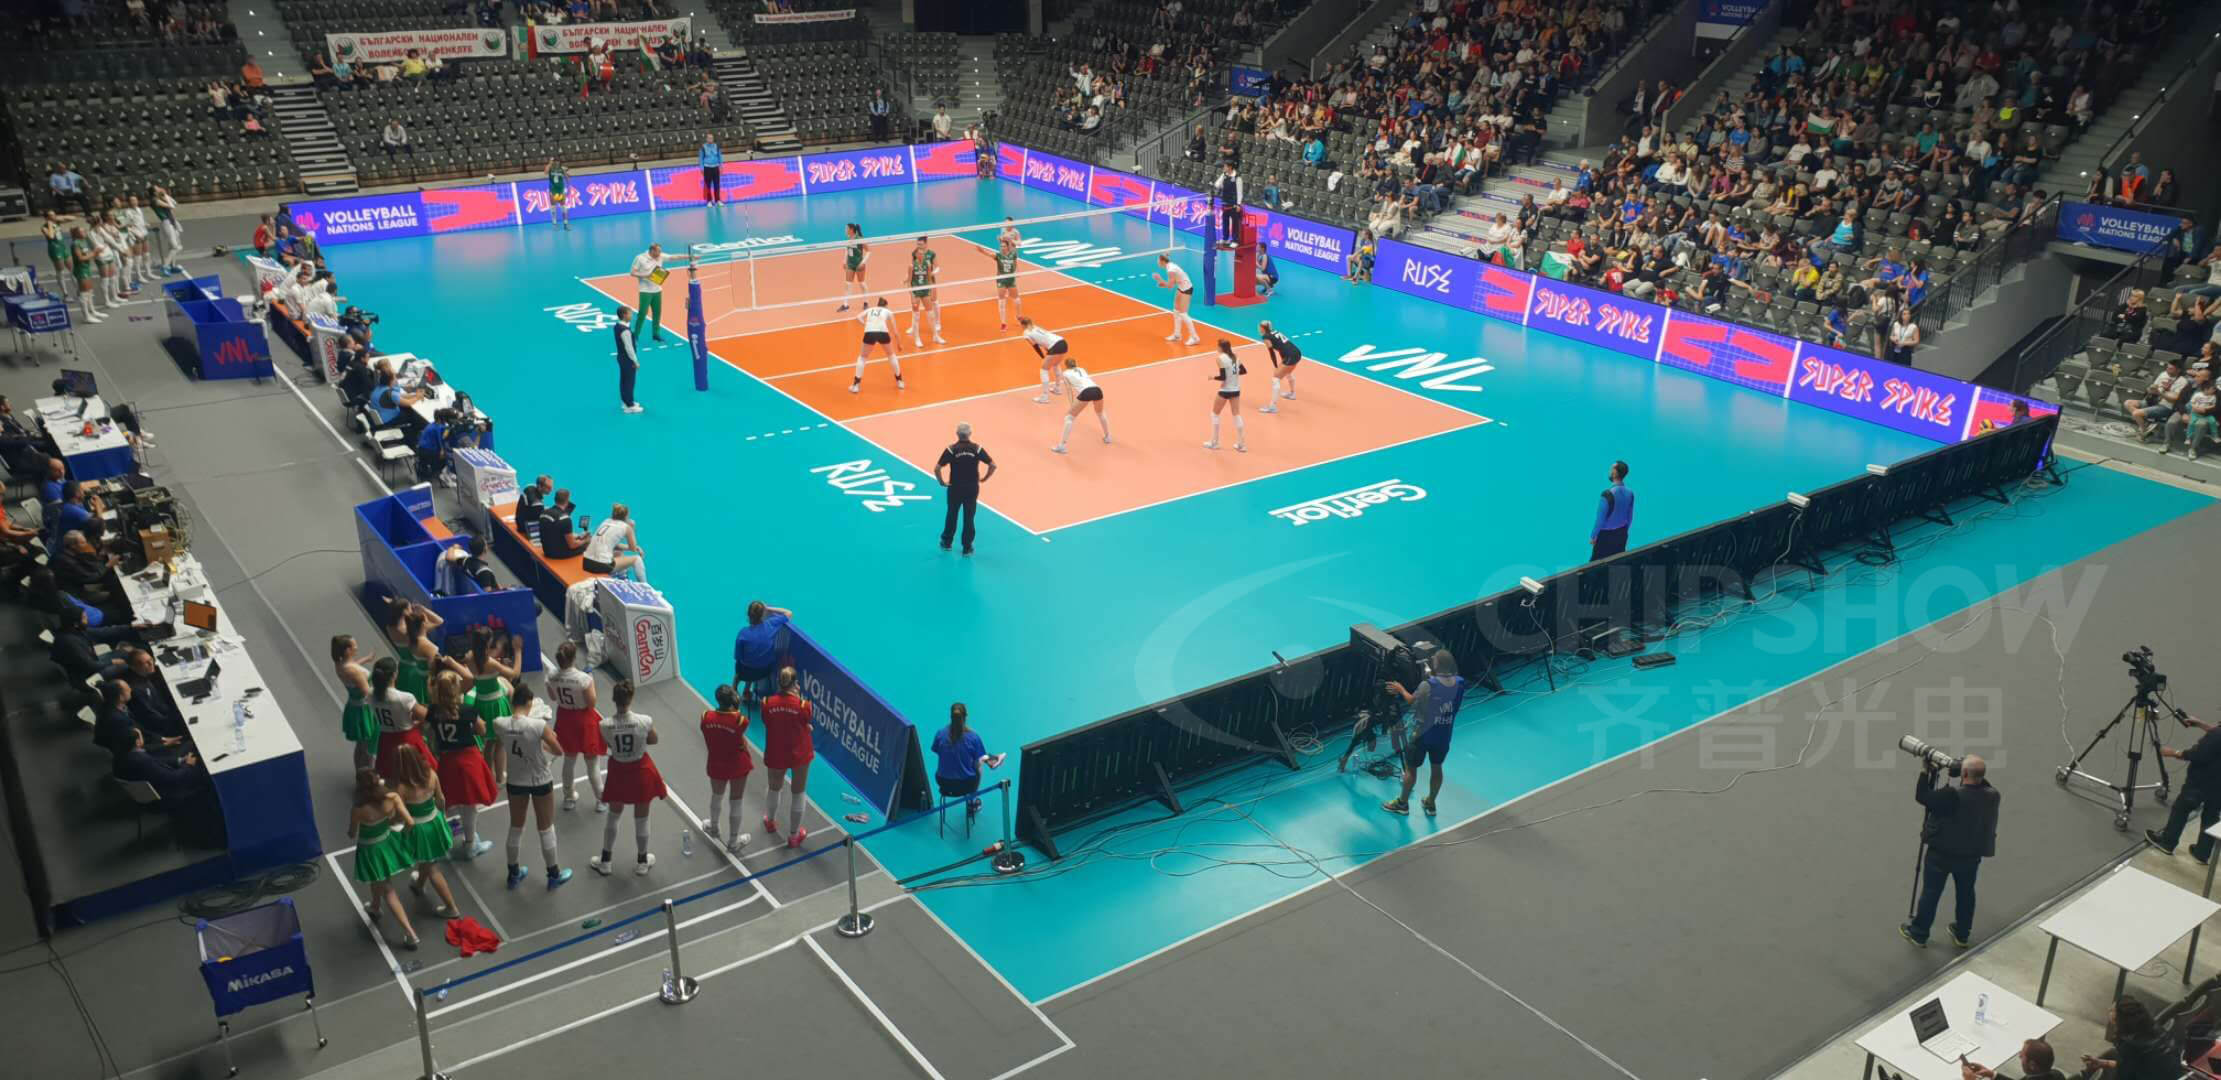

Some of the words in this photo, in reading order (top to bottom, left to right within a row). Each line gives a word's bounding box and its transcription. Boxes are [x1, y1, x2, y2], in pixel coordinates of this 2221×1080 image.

[360, 35, 413, 46] БЪЛГАРСКИ
[418, 32, 478, 43] НАЦИОНАЛЕН
[563, 27, 609, 36] БЪЛГАРСКИ
[808, 159, 857, 184] SUPER
[860, 154, 904, 179] SPIKE
[586, 180, 640, 207] SPIKE
[323, 204, 416, 224] VOLLEYBALL
[326, 222, 375, 235] NATIONS
[377, 217, 418, 230] LEAGUE
[1287, 226, 1341, 252] VOLLEYBALL
[2098, 226, 2136, 239] NATIONS
[1284, 240, 1313, 255] NATIONS
[1314, 249, 1340, 263] LEAGUE
[1402, 258, 1453, 293] RUSE
[1534, 288, 1591, 326] SUPER
[1595, 303, 1652, 343] SPIKE
[1337, 344, 1496, 392] VNL
[1799, 356, 1875, 402] SUPER
[1879, 377, 1957, 427] SPIKE
[809, 459, 933, 512] RUSE
[557, 686, 575, 705] 15
[803, 668, 881, 756] VOLLEYBALL
[438, 723, 458, 743] 12
[614, 734, 634, 754] 19
[812, 702, 841, 739] TIONS
[841, 730, 880, 775] LEAGUE
[511, 739, 523, 758] 4
